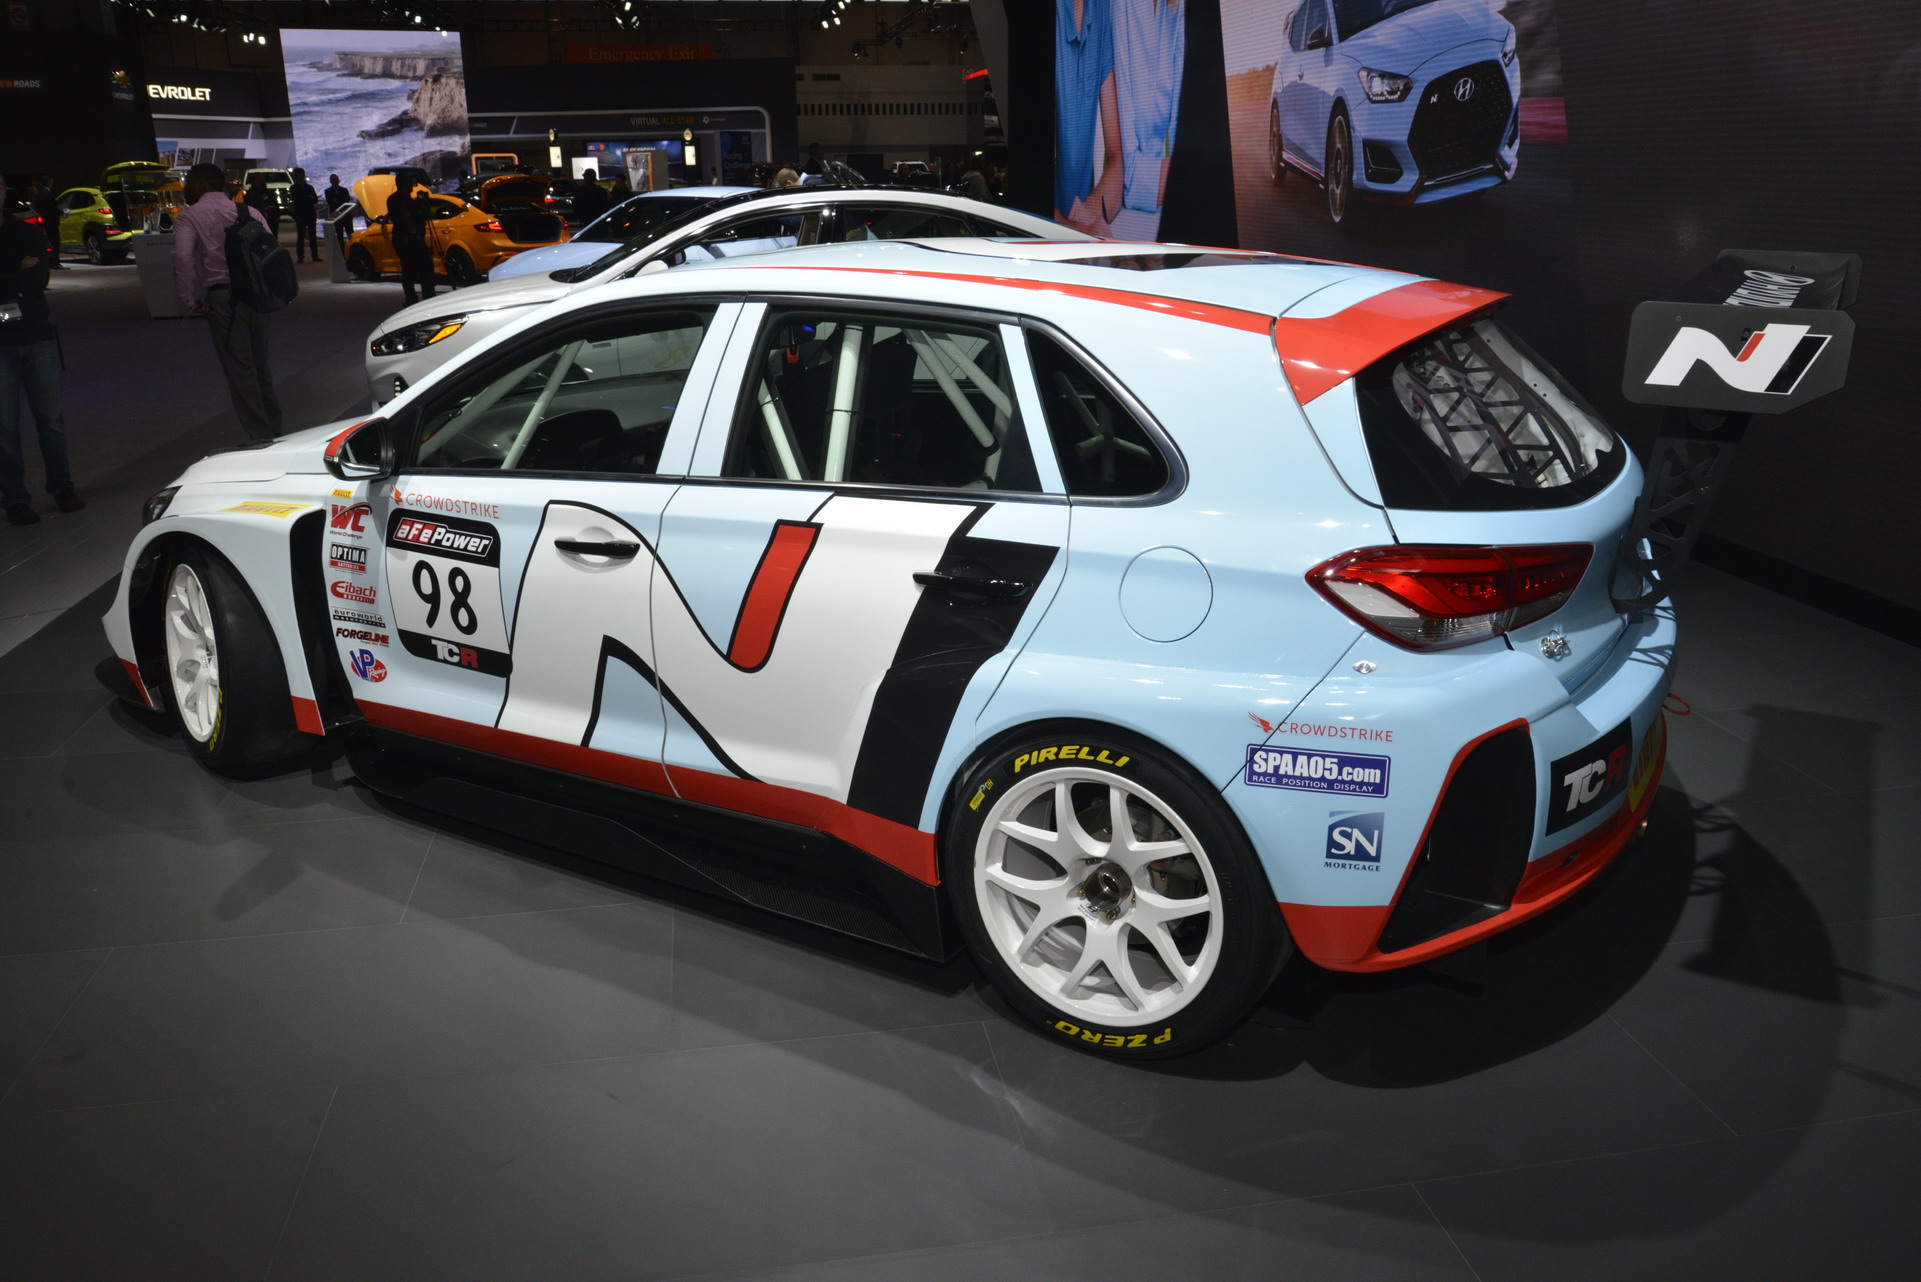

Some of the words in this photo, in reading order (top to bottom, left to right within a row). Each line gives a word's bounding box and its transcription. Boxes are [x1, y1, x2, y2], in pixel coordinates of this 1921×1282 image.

[589, 47, 664, 63] Emergency
[669, 47, 697, 61] Exit
[630, 117, 660, 126] VIRTUAL
[406, 493, 500, 520] CROWDSTRIKE
[331, 546, 365, 564] OPTIMA
[330, 581, 377, 600] Eibach
[412, 560, 478, 636] 98
[334, 609, 383, 622] euroworld
[336, 627, 390, 645] FORGELINE
[349, 648, 375, 678] VP
[431, 639, 479, 669] TCR
[1278, 721, 1393, 743] CROWDSTRIKE
[1014, 745, 1131, 774] PIRELLI
[1252, 775, 1277, 785] RACE
[1282, 778, 1328, 789] POSITION
[1333, 783, 1374, 793] DISPLAY
[1563, 744, 1627, 813] TCR
[1330, 826, 1379, 857] SN
[1324, 861, 1382, 872] MORTGAGE
